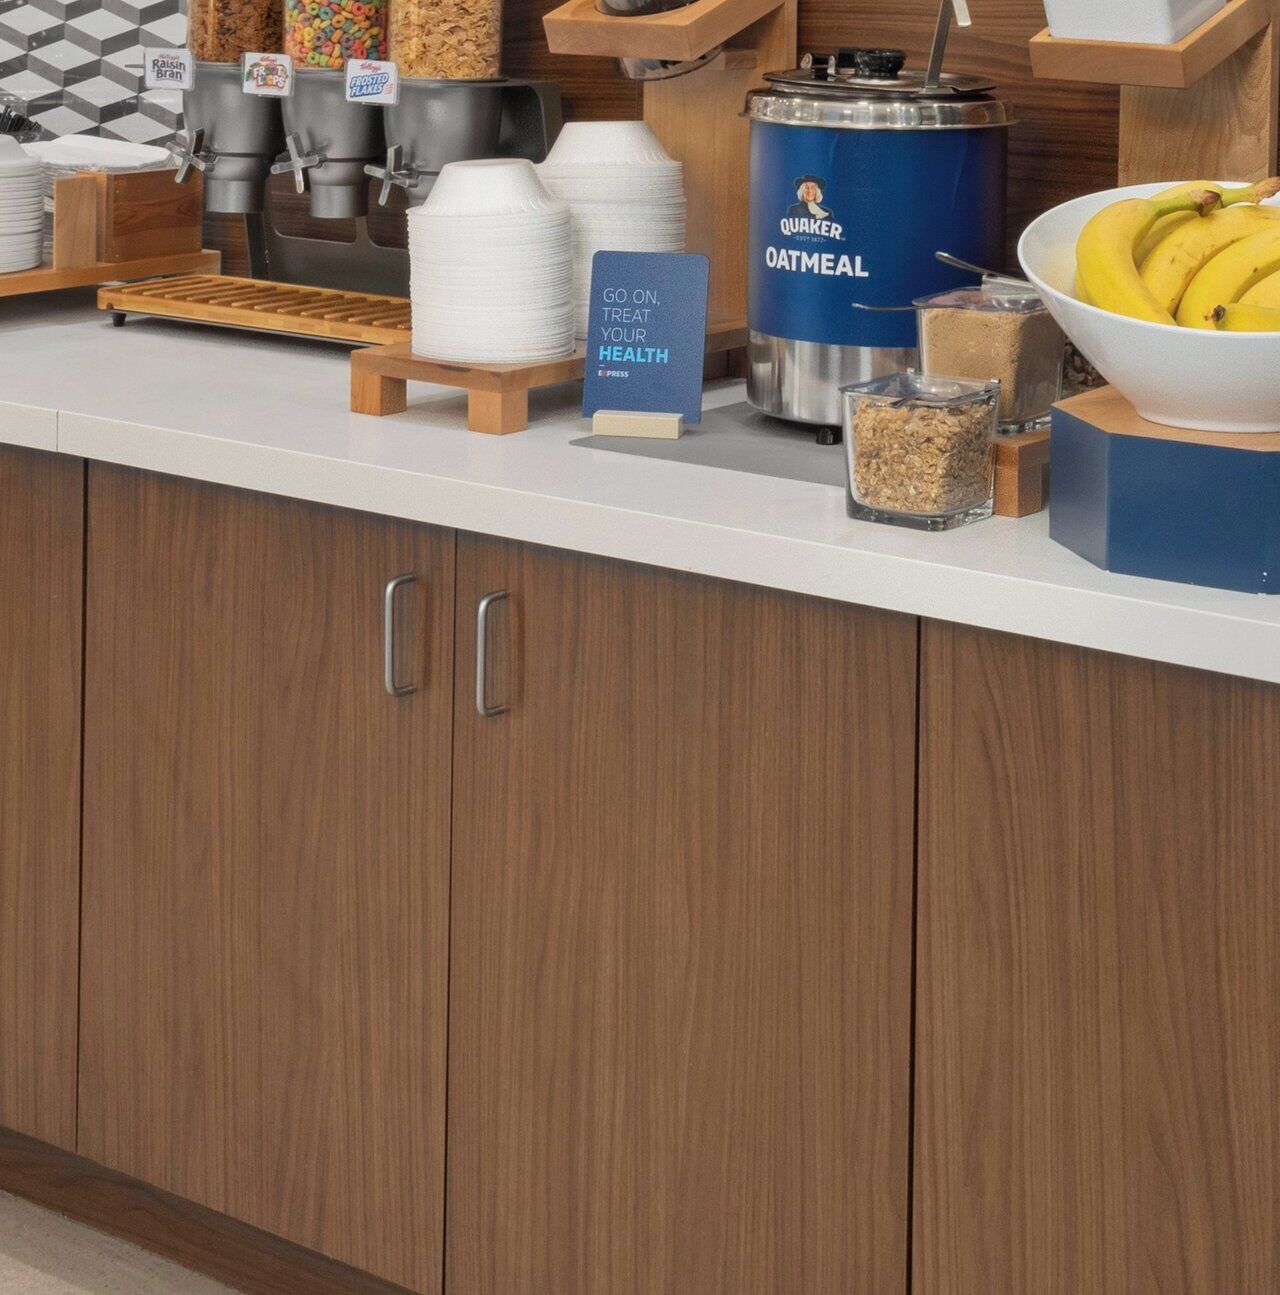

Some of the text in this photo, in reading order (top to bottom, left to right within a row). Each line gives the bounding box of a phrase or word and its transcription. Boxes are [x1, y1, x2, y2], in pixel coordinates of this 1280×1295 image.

[152, 58, 186, 72] Raisin
[156, 69, 183, 81] Bran
[350, 72, 390, 88] FROSTED
[350, 83, 385, 97] FLAKES
[780, 217, 843, 240] QUAKER
[765, 246, 870, 277] OATMEAL
[603, 288, 661, 306] GO ON,
[602, 307, 651, 323] TREAT
[600, 327, 647, 343] YOUR
[598, 345, 670, 363] HEALTH
